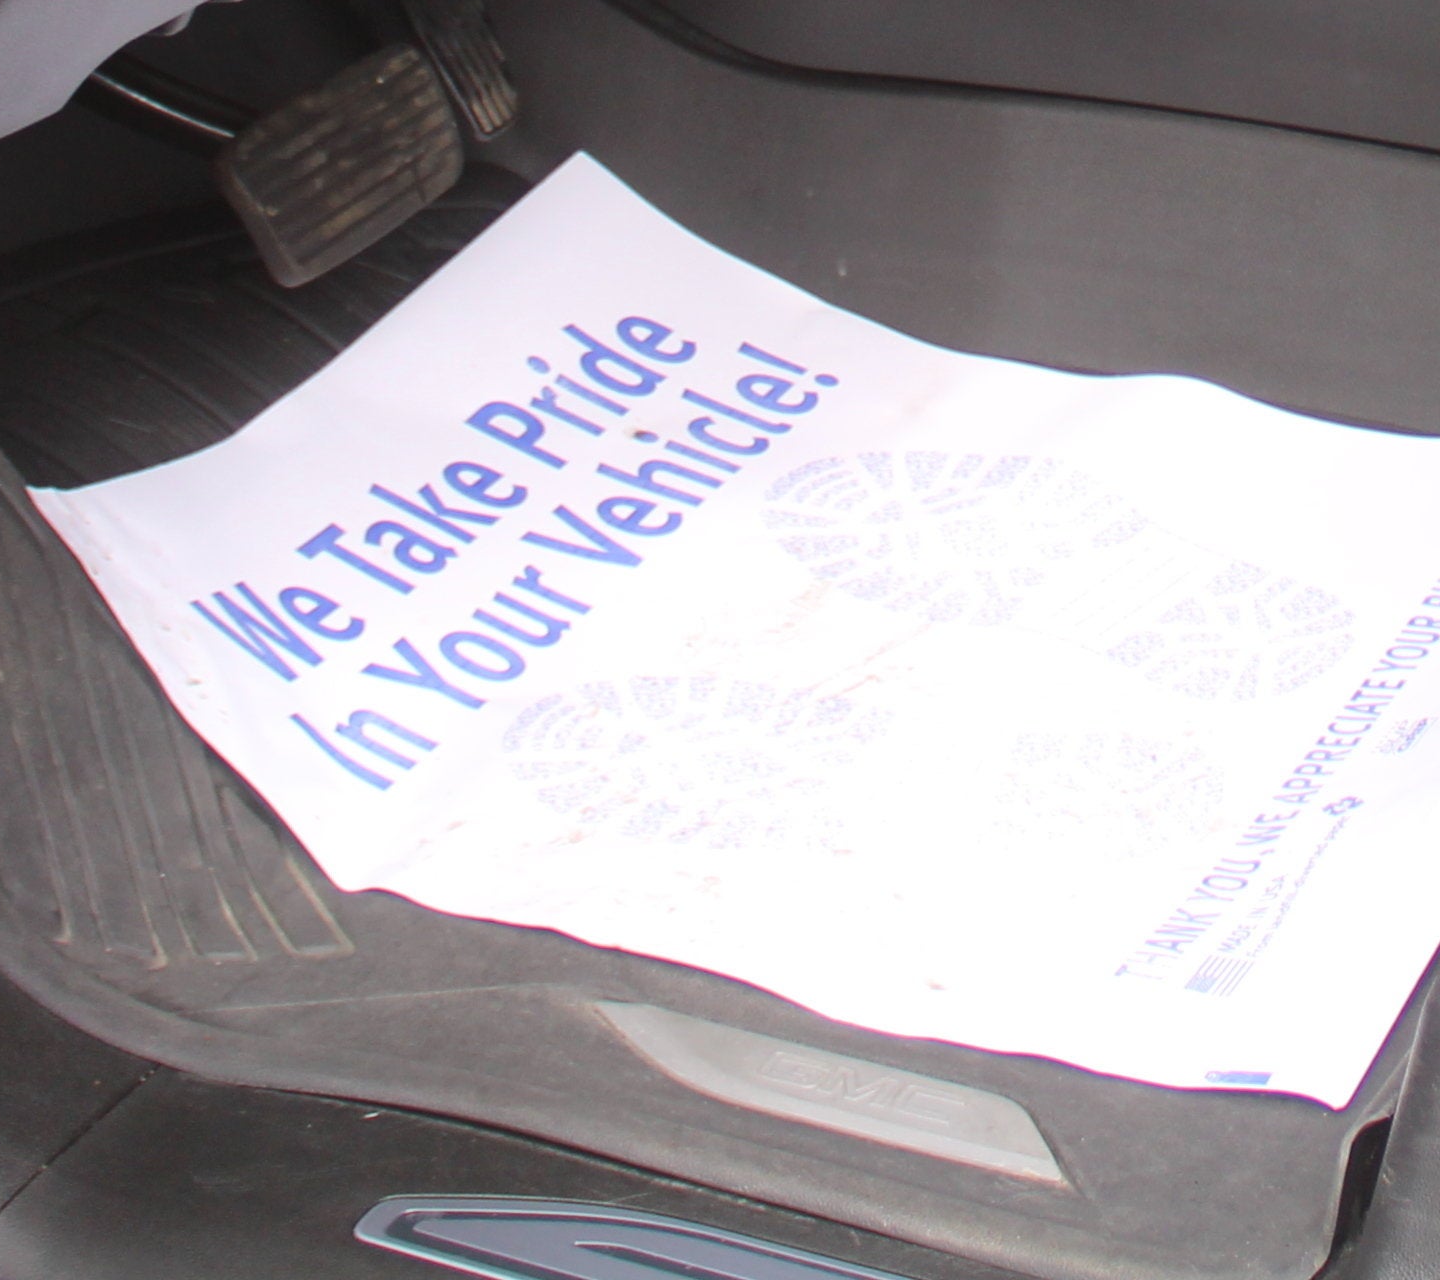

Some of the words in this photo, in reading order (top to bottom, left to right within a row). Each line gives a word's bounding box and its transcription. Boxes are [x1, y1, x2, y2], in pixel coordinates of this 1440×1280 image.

[189, 582, 366, 684] We
[294, 482, 529, 596] Take
[463, 315, 697, 471] Pride
[519, 342, 840, 569] Vehicle!
[360, 564, 593, 712] Your
[289, 709, 439, 792] In
[1114, 907, 1222, 981] THANK
[1185, 848, 1276, 903] YOU,
[1235, 809, 1302, 847] WE
[1273, 678, 1406, 804] APPRECIATE
[759, 1049, 965, 1127] GMC
